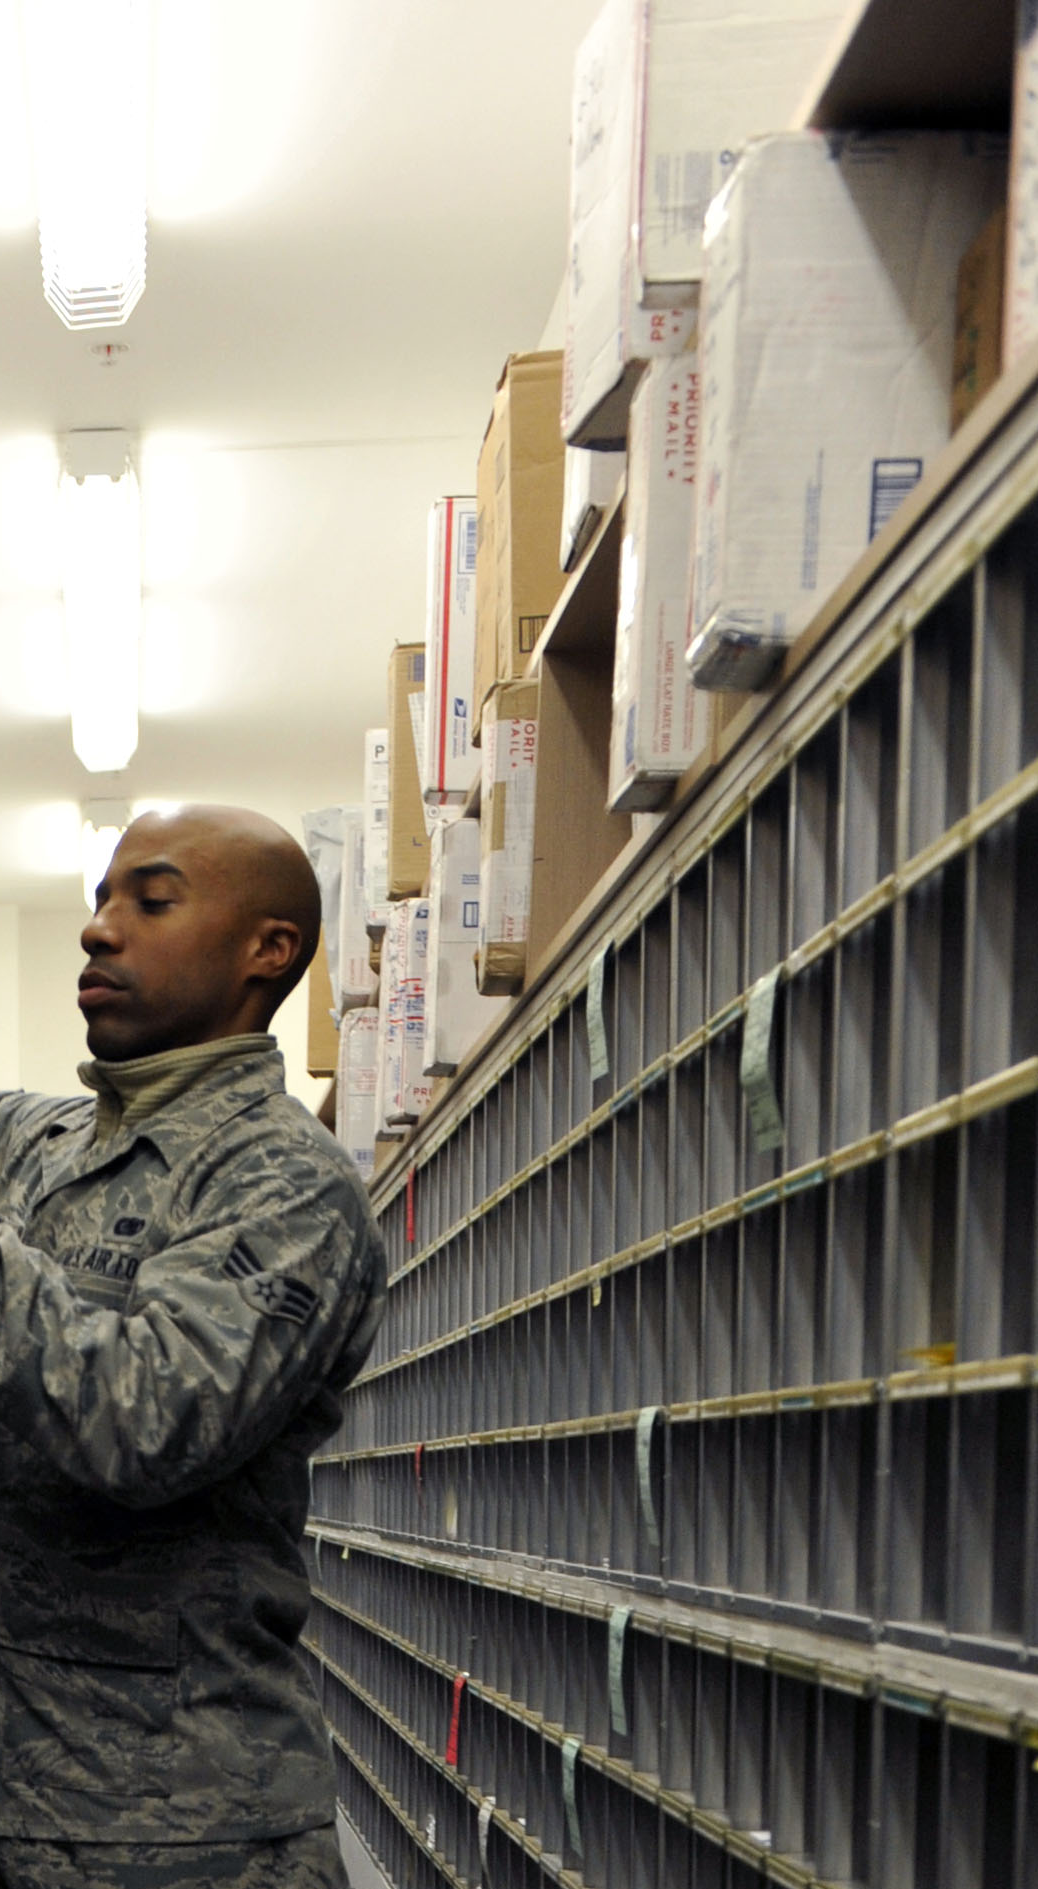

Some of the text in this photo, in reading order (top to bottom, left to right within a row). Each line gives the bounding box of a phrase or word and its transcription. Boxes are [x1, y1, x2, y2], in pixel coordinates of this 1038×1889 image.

[665, 401, 681, 460] MAIL
[660, 640, 675, 753] LARGE FLAT RATE BOX
[82, 1247, 113, 1275] AIR
